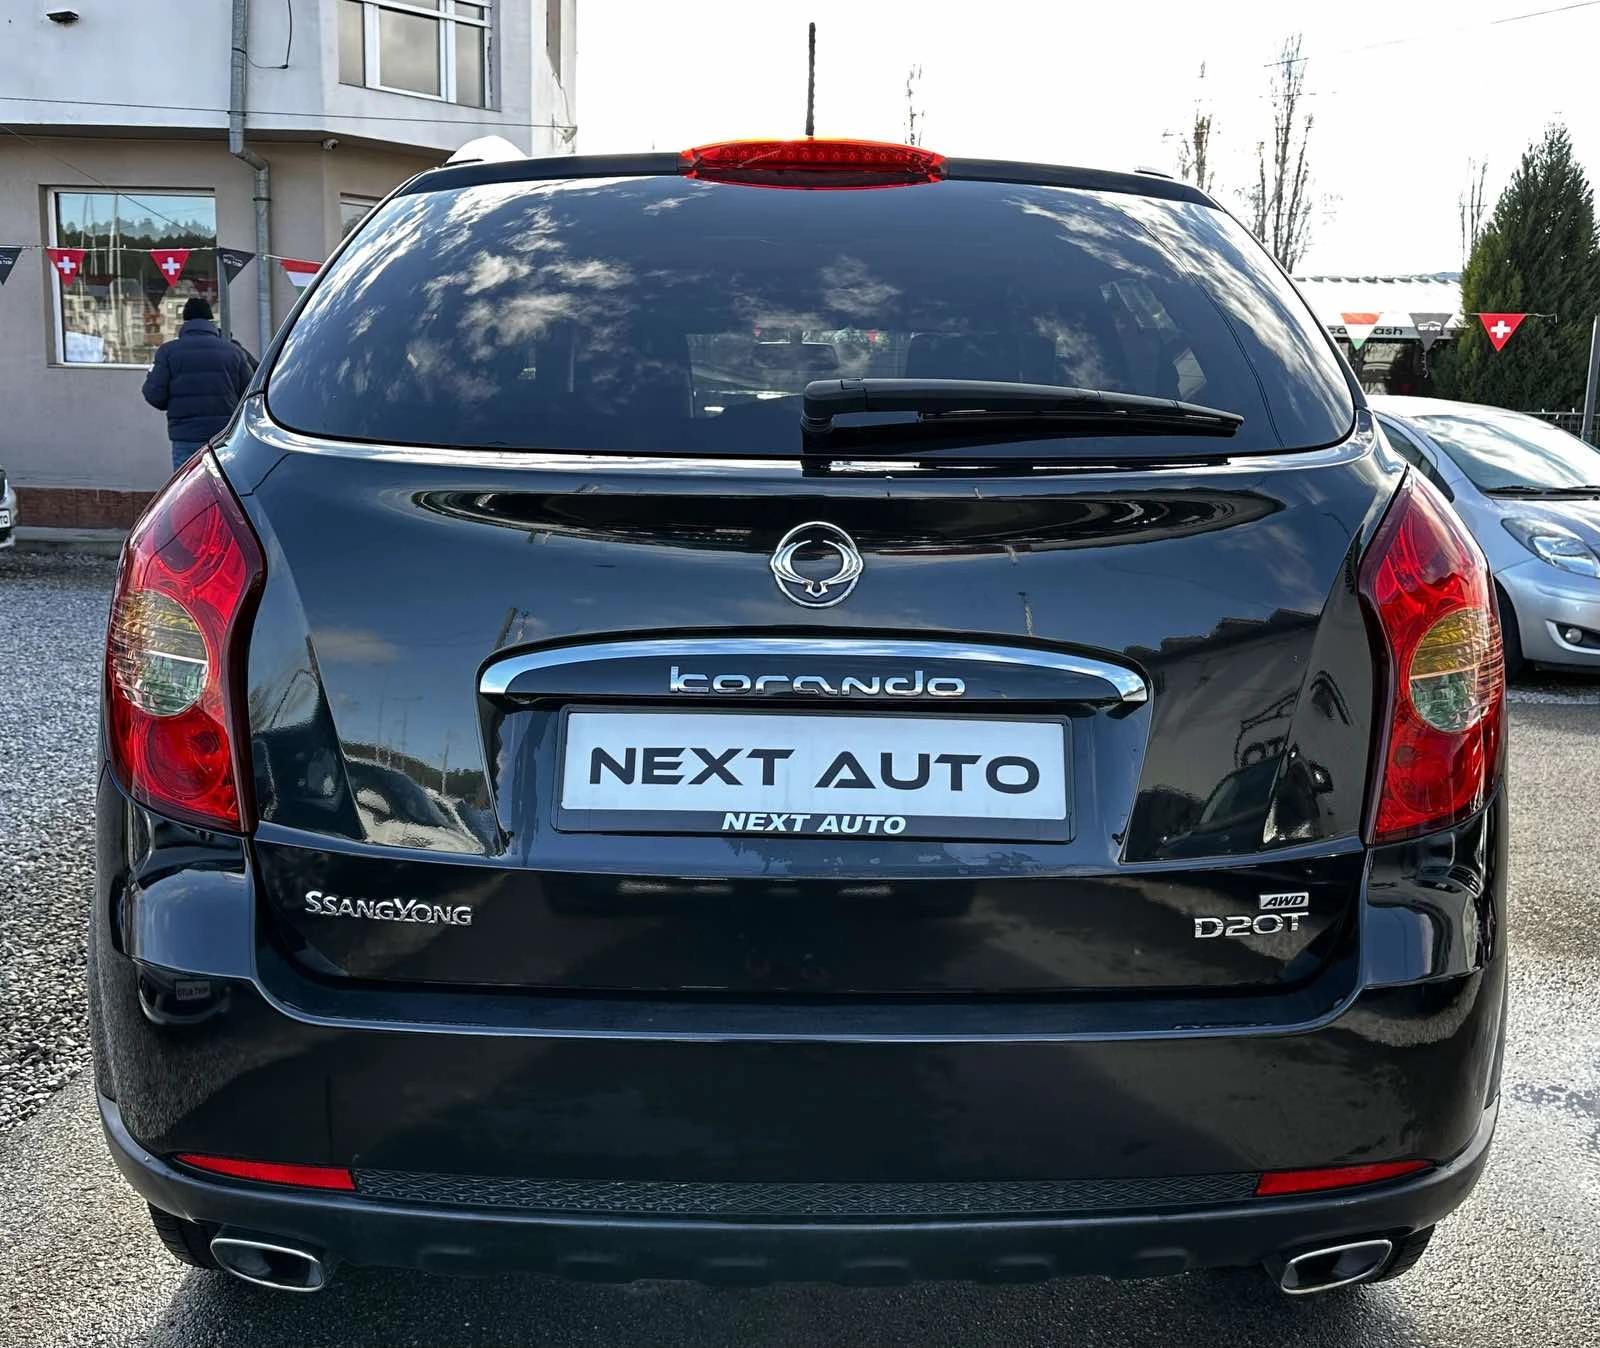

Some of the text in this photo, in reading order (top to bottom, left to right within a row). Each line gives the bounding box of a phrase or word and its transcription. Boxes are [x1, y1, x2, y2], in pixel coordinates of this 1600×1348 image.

[1373, 326, 1403, 335] ash
[669, 665, 966, 697] korando
[590, 747, 1040, 794] NEXT AUTO
[722, 813, 906, 834] NEXT AUTO
[305, 890, 472, 925] SSANGYONG
[1262, 895, 1306, 907] AWD
[1194, 911, 1309, 938] D20T
